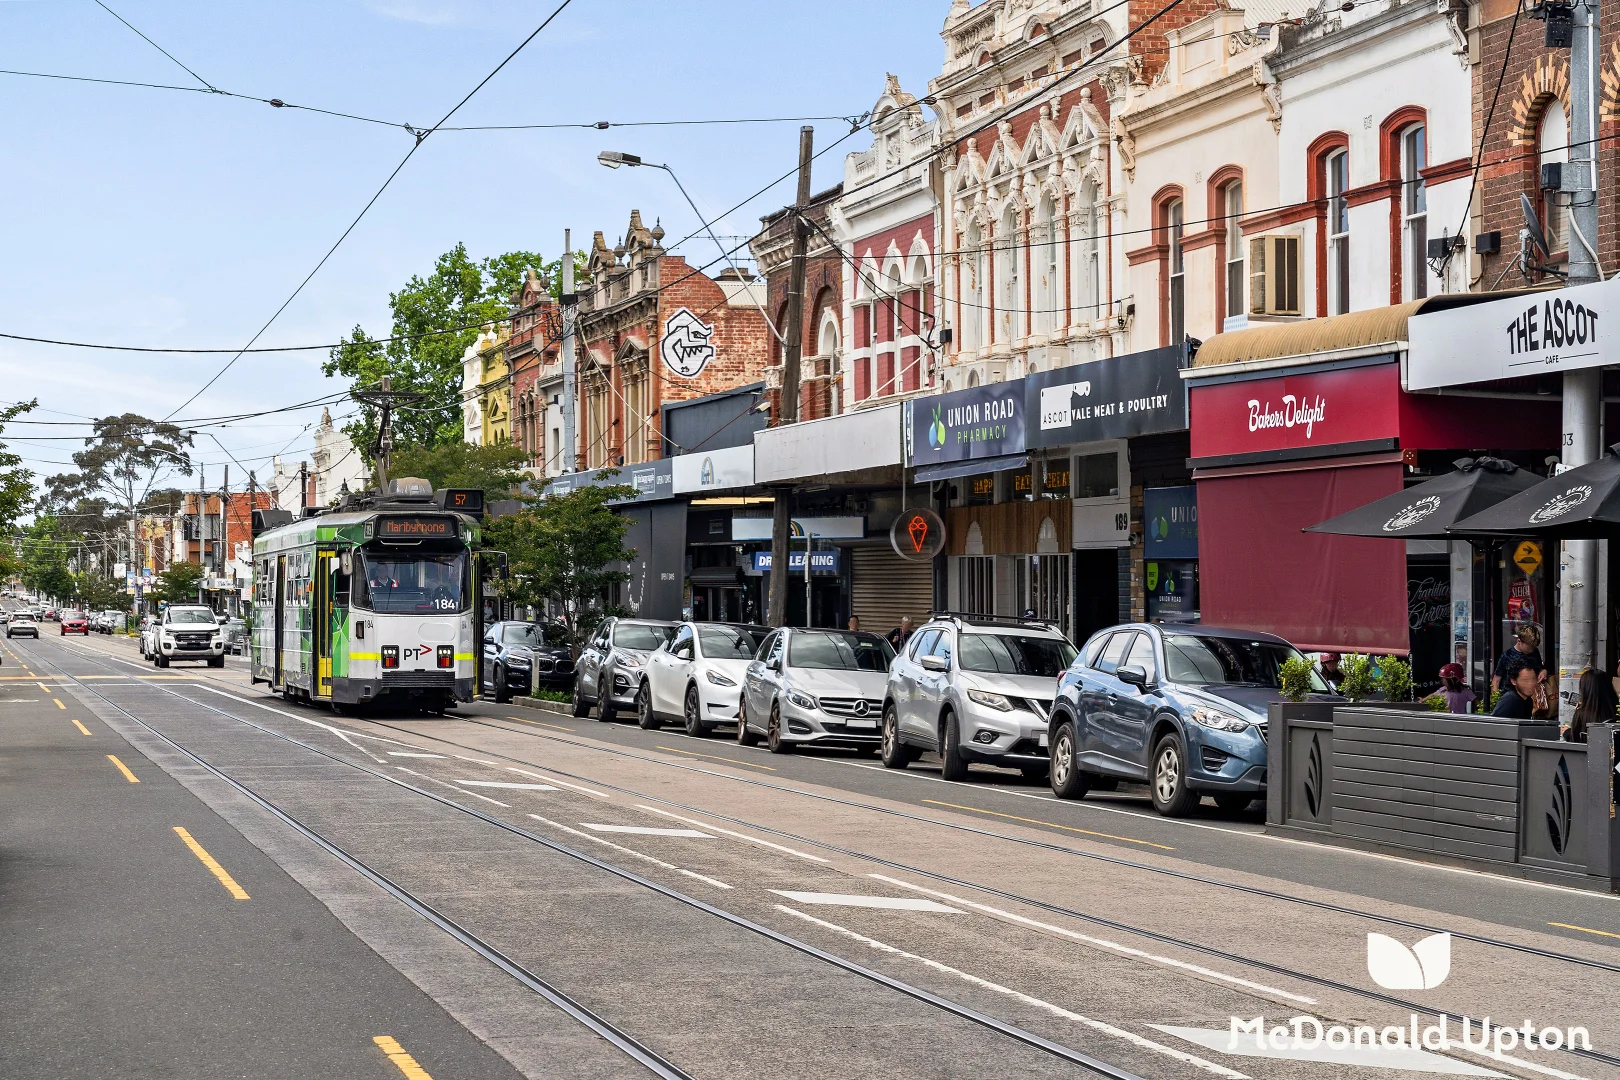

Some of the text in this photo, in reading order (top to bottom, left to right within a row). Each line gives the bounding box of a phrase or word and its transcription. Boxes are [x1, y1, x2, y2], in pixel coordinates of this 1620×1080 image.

[1506, 297, 1598, 355] THE ASCOT
[1545, 354, 1559, 365] CAFE
[947, 397, 1015, 428] UNION ROAD
[1042, 394, 1168, 425] ASCOT VALE MEAT & POULTRY
[1247, 394, 1326, 439] Bakers Delight
[957, 424, 1007, 444] PHARMACY
[455, 494, 466, 505] 57
[1115, 512, 1128, 531] 189
[1171, 505, 1197, 523] UNIO
[758, 555, 834, 567] DR LEANING
[434, 599, 456, 610] 184
[364, 620, 374, 629] 184
